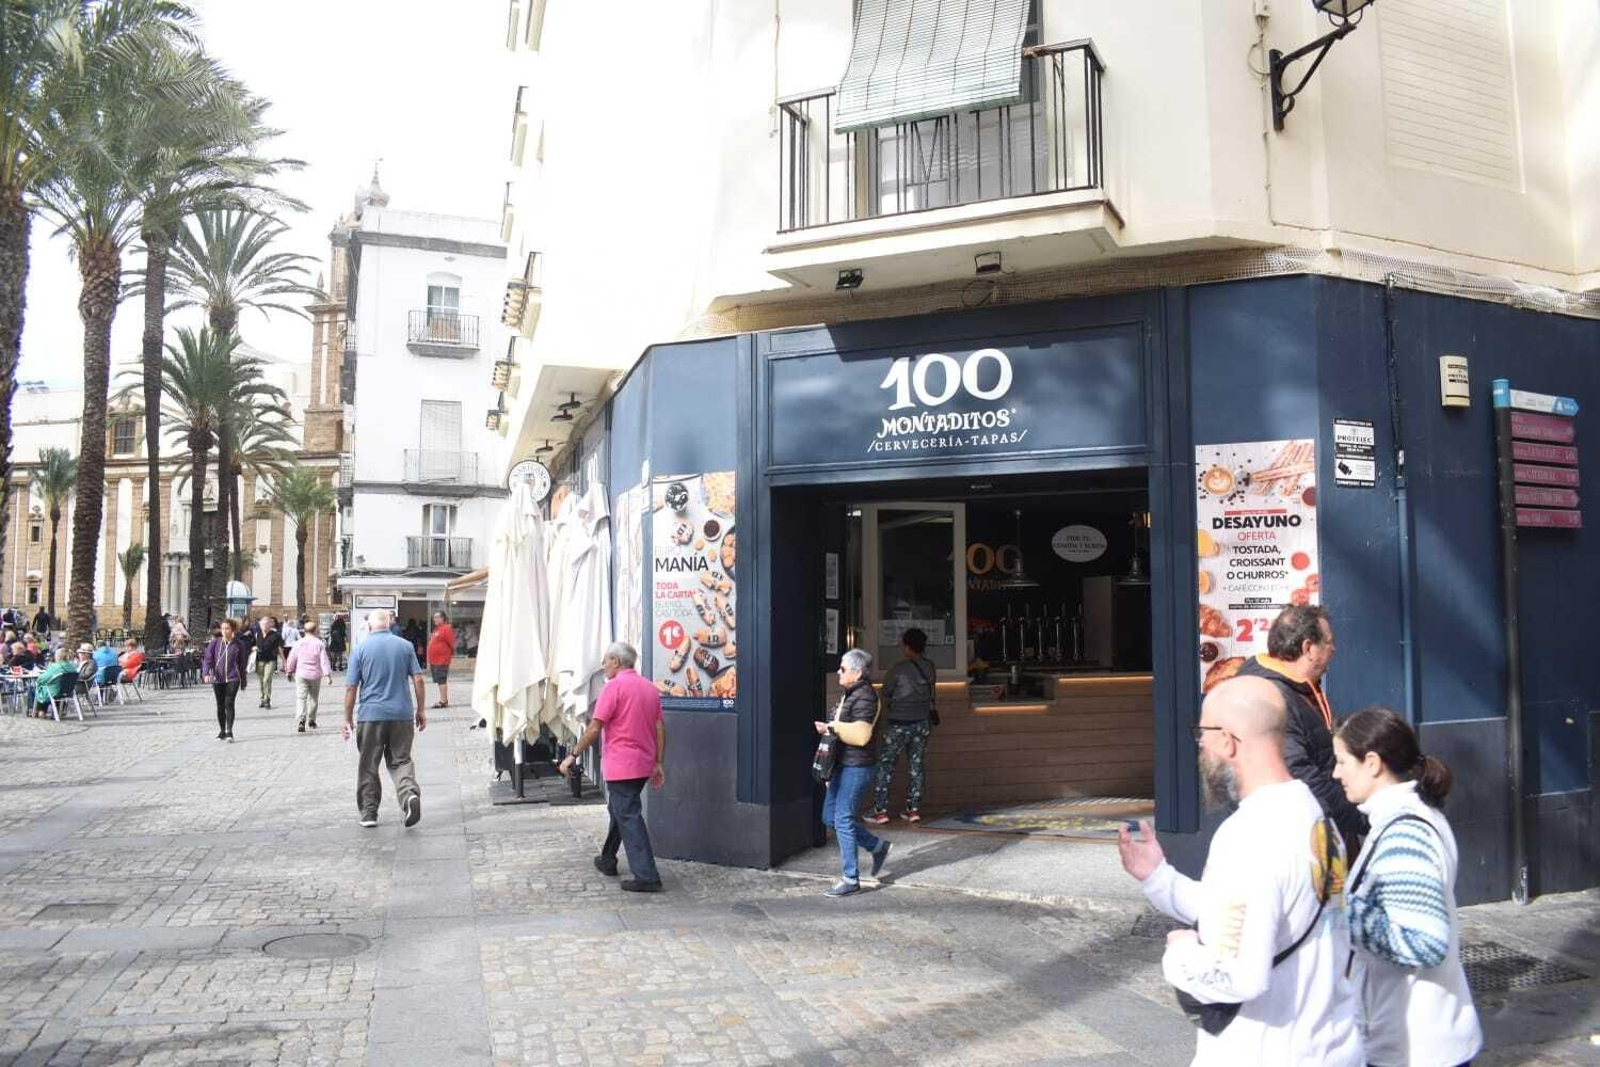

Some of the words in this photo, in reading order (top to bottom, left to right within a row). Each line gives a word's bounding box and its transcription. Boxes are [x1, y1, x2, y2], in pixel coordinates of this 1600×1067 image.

[879, 348, 1013, 410] 100
[876, 408, 1011, 439] MONTADITOS
[1212, 514, 1302, 529] DESAYUNO
[1237, 531, 1277, 542] OFERTA
[1232, 545, 1281, 555] TOSTADA,
[655, 552, 709, 573] MANÍA
[1229, 557, 1286, 568] CROISSANT
[1226, 571, 1235, 580] O
[656, 582, 679, 590] TODA
[656, 591, 666, 599] LA
